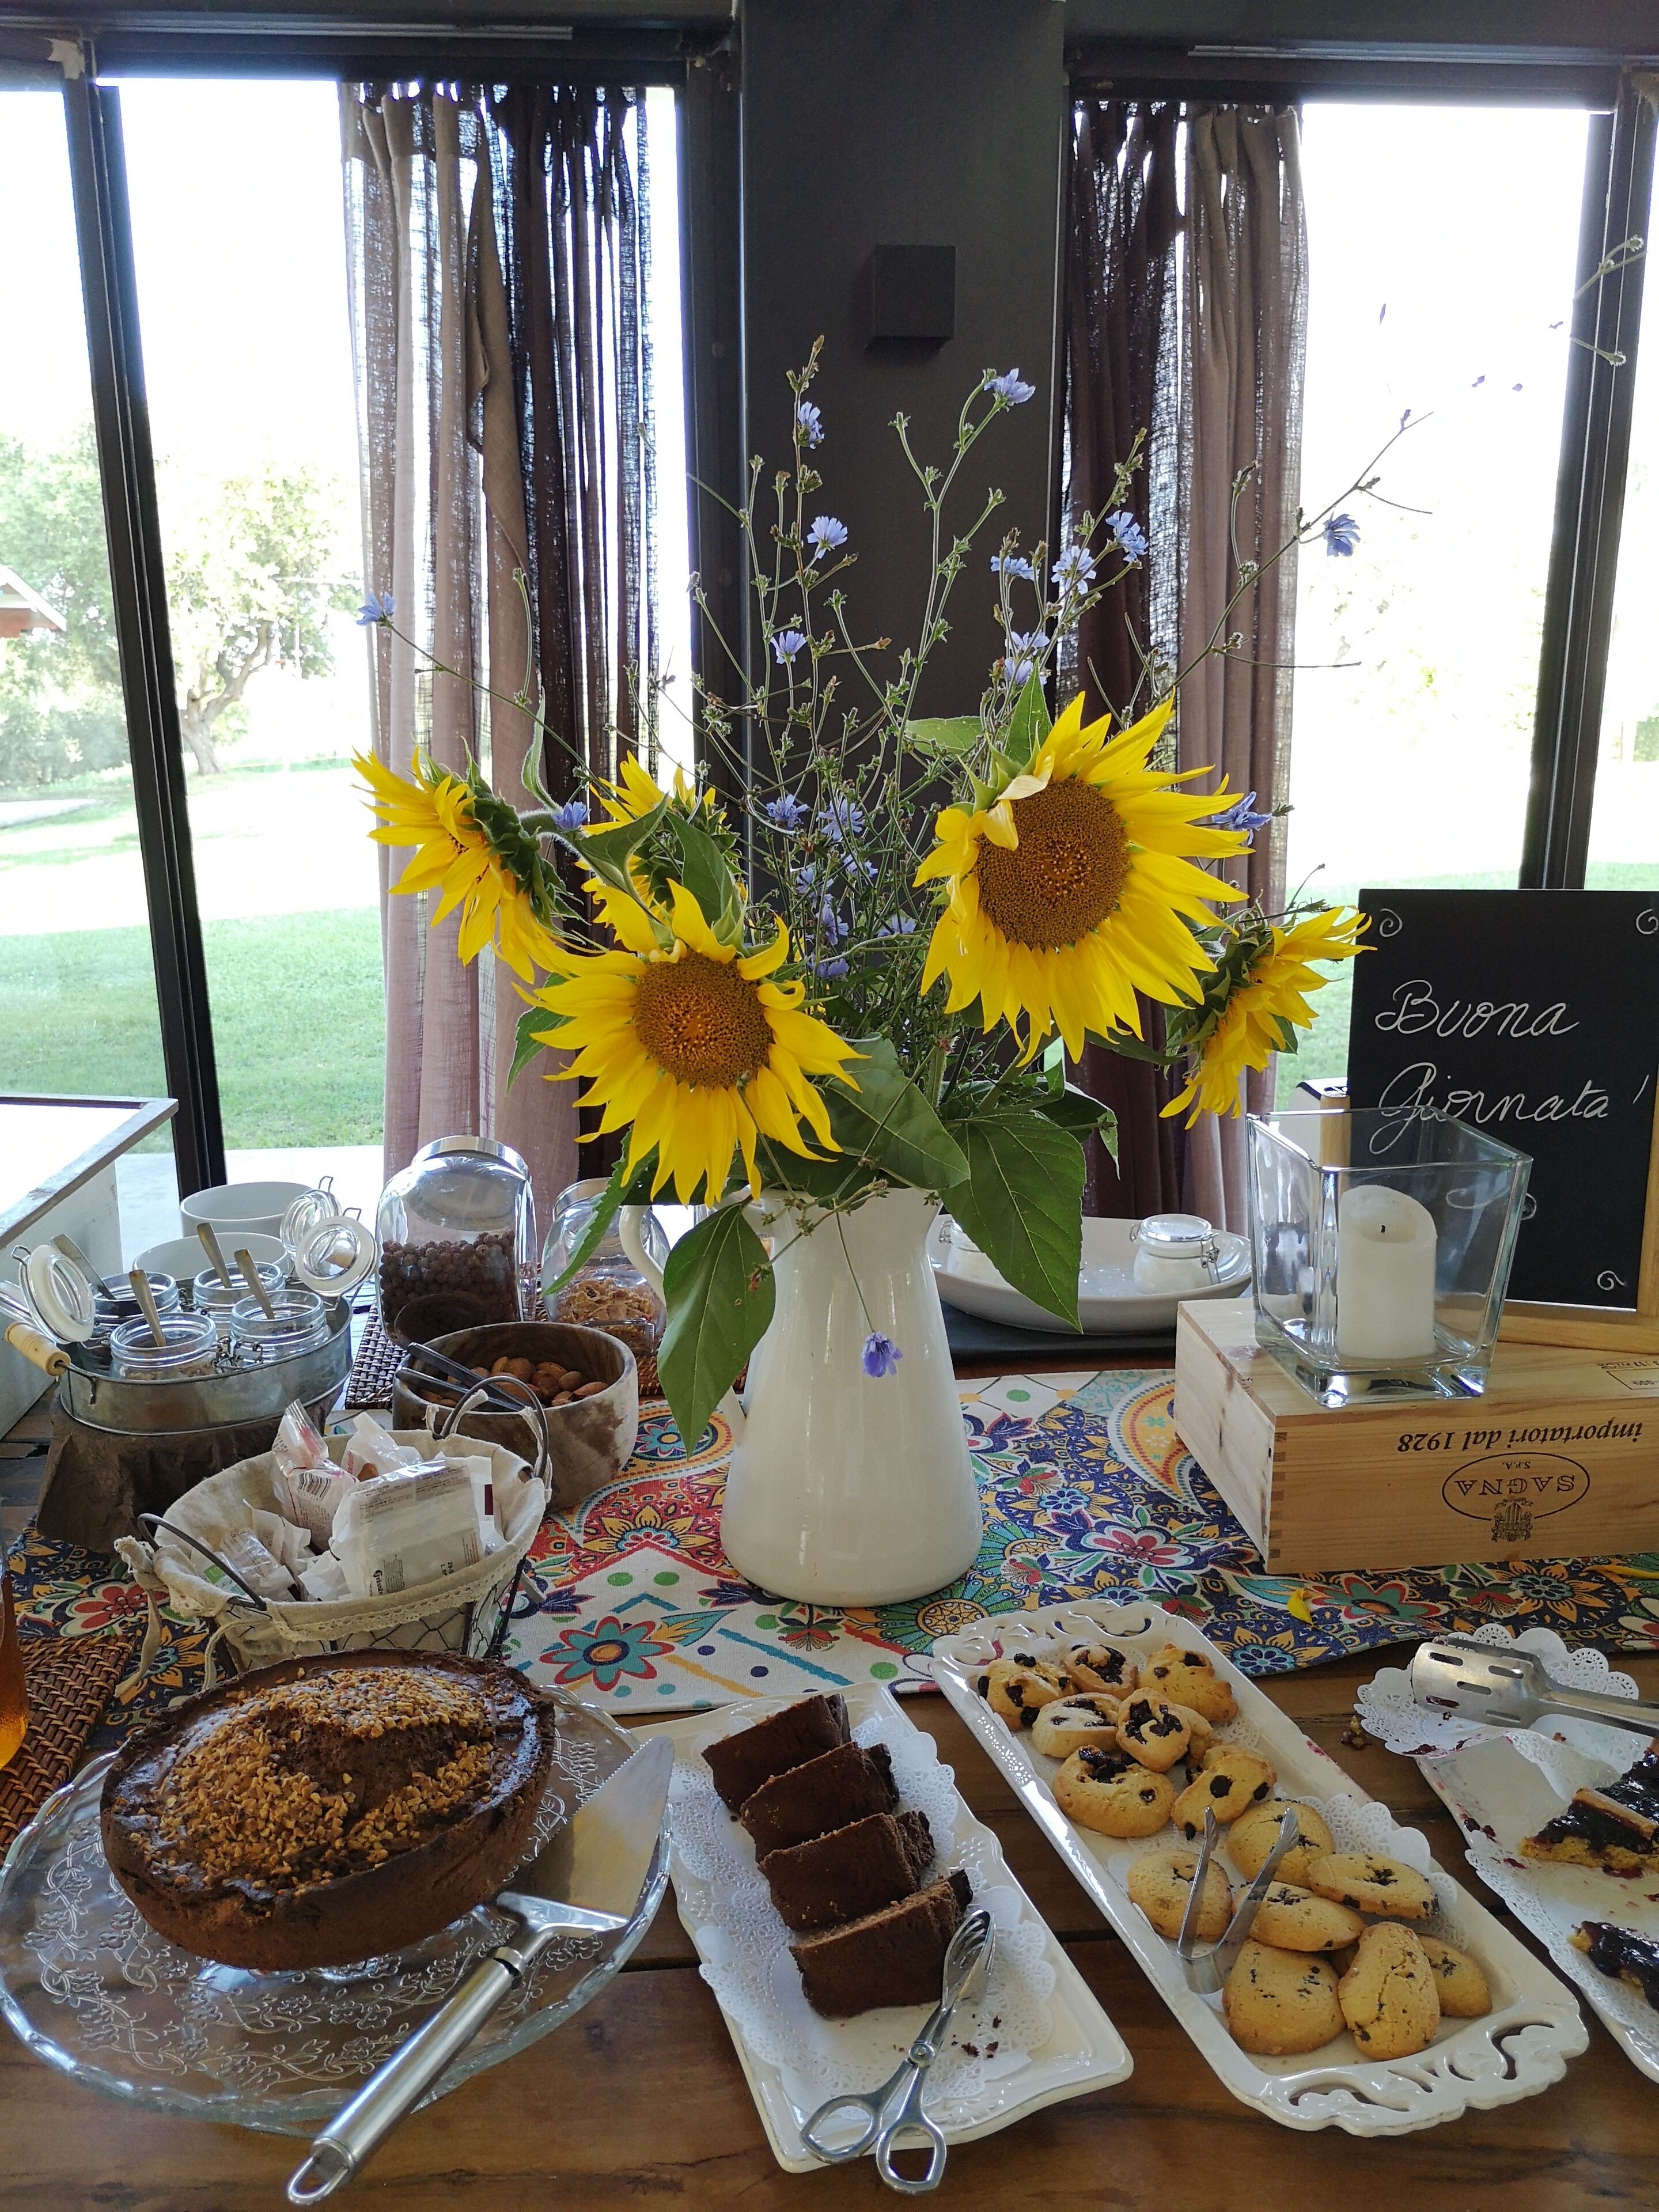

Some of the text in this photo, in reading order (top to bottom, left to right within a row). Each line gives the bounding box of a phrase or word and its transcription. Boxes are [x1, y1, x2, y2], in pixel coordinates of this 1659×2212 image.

[1374, 979, 1580, 1038] Buona
[1369, 1062, 1609, 1154] Giornata
[1397, 1417, 1643, 1452] importatori dal 1928
[1455, 1475, 1576, 1497] SAGNA
